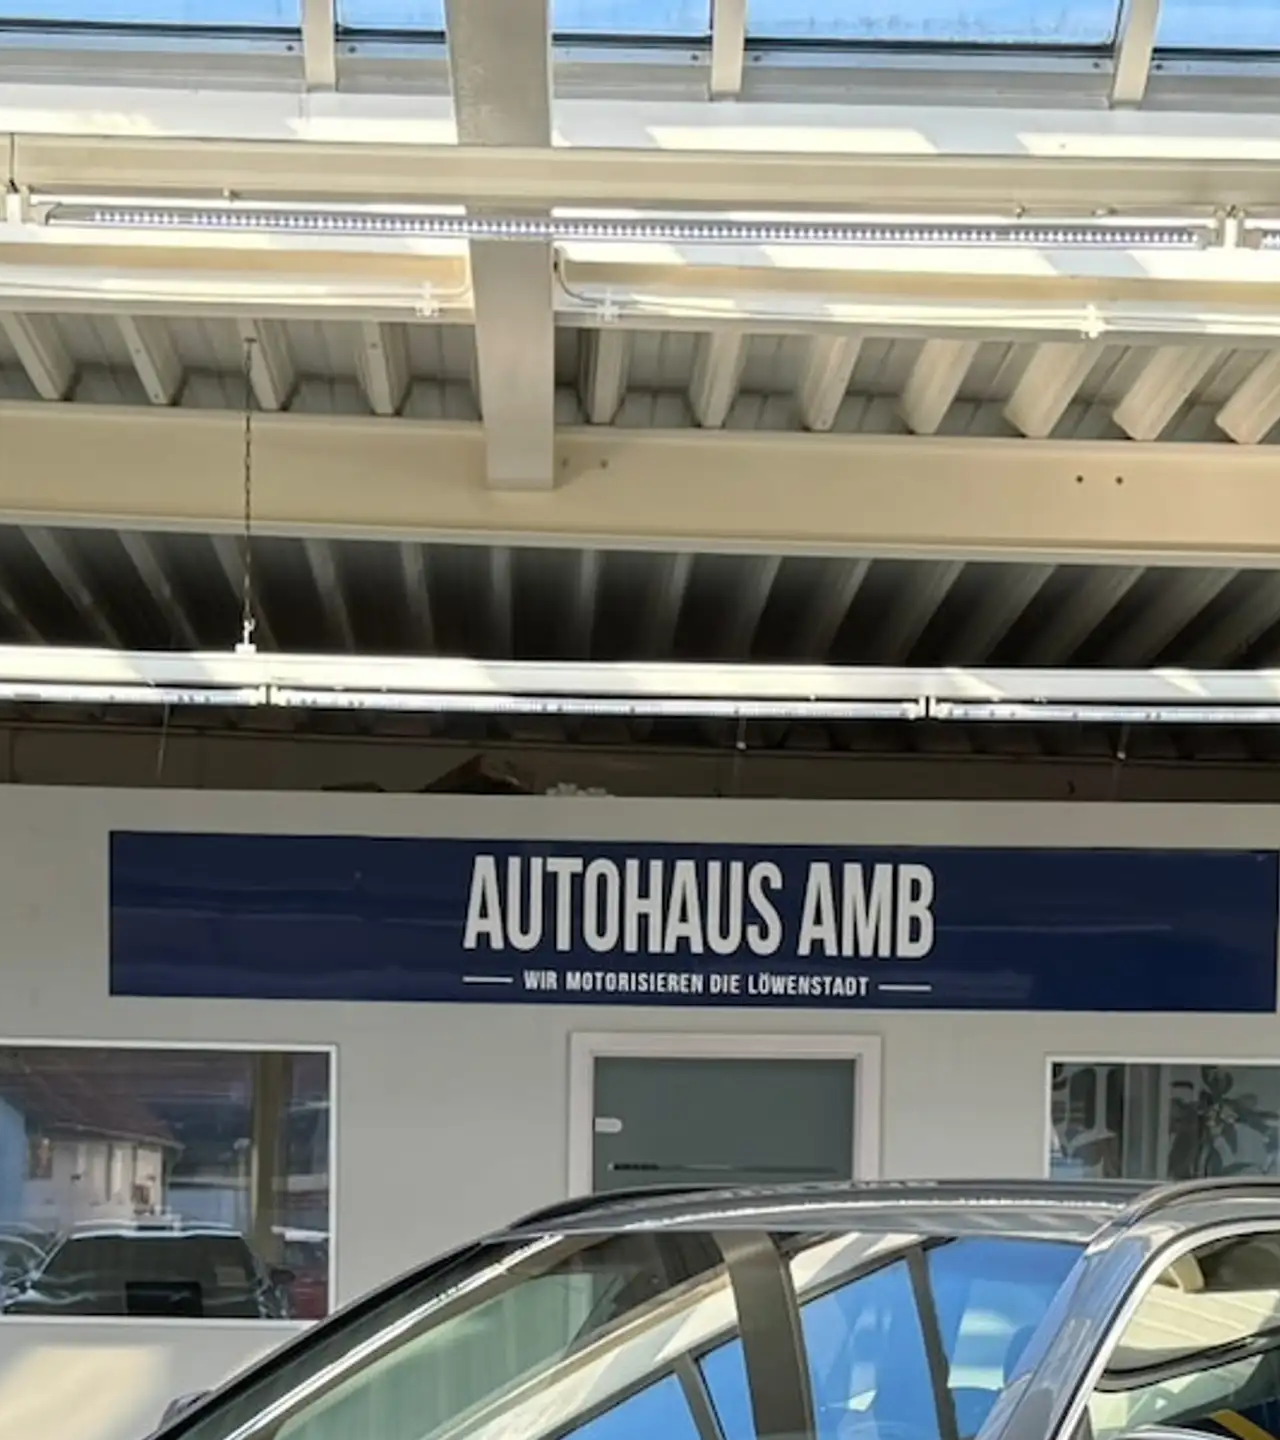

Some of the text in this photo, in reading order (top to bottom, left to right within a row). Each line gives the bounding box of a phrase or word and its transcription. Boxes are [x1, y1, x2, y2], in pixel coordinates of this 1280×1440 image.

[463, 854, 935, 958] AUTOHAUS AMB
[524, 969, 870, 997] WIR MOTORISIEREN DIE LÖWENSTADT
